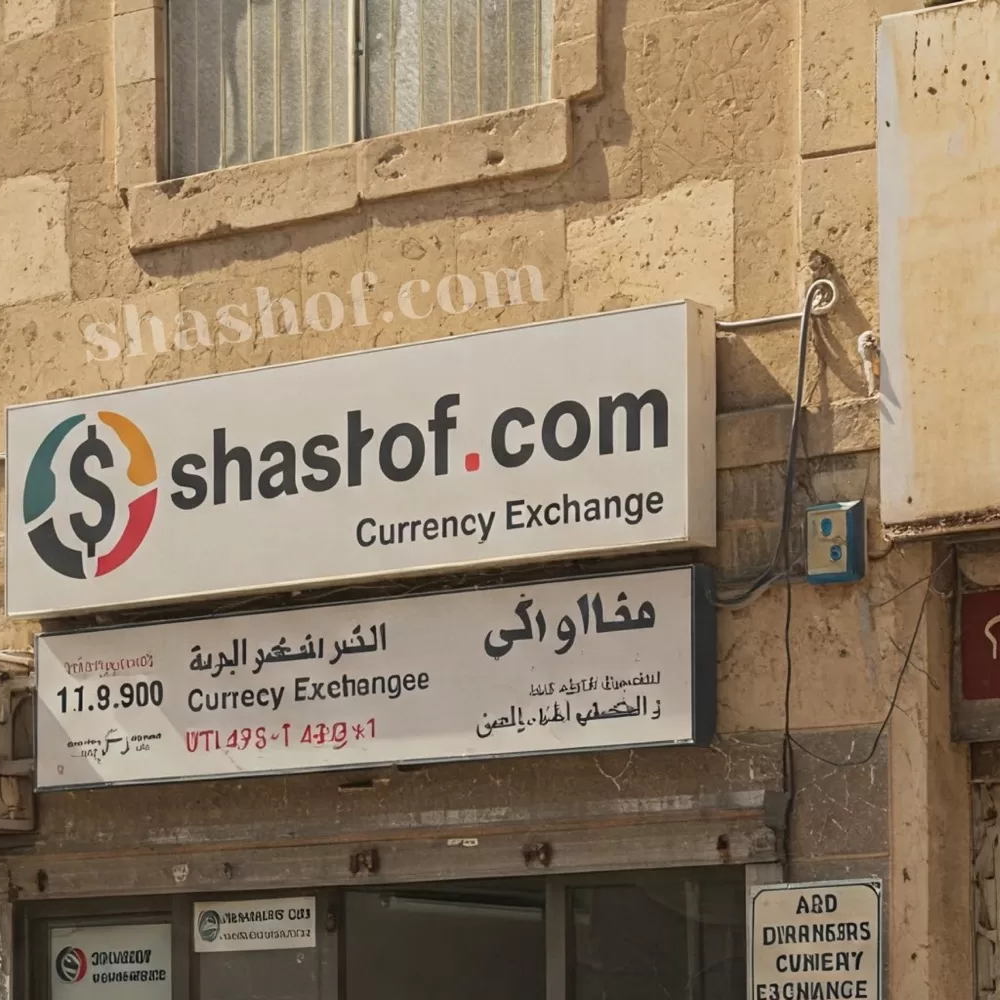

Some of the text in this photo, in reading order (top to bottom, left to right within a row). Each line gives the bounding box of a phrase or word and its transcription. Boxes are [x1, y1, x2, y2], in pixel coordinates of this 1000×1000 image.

[357, 491, 664, 547] Currency Exchange
[188, 684, 285, 712] Currecy
